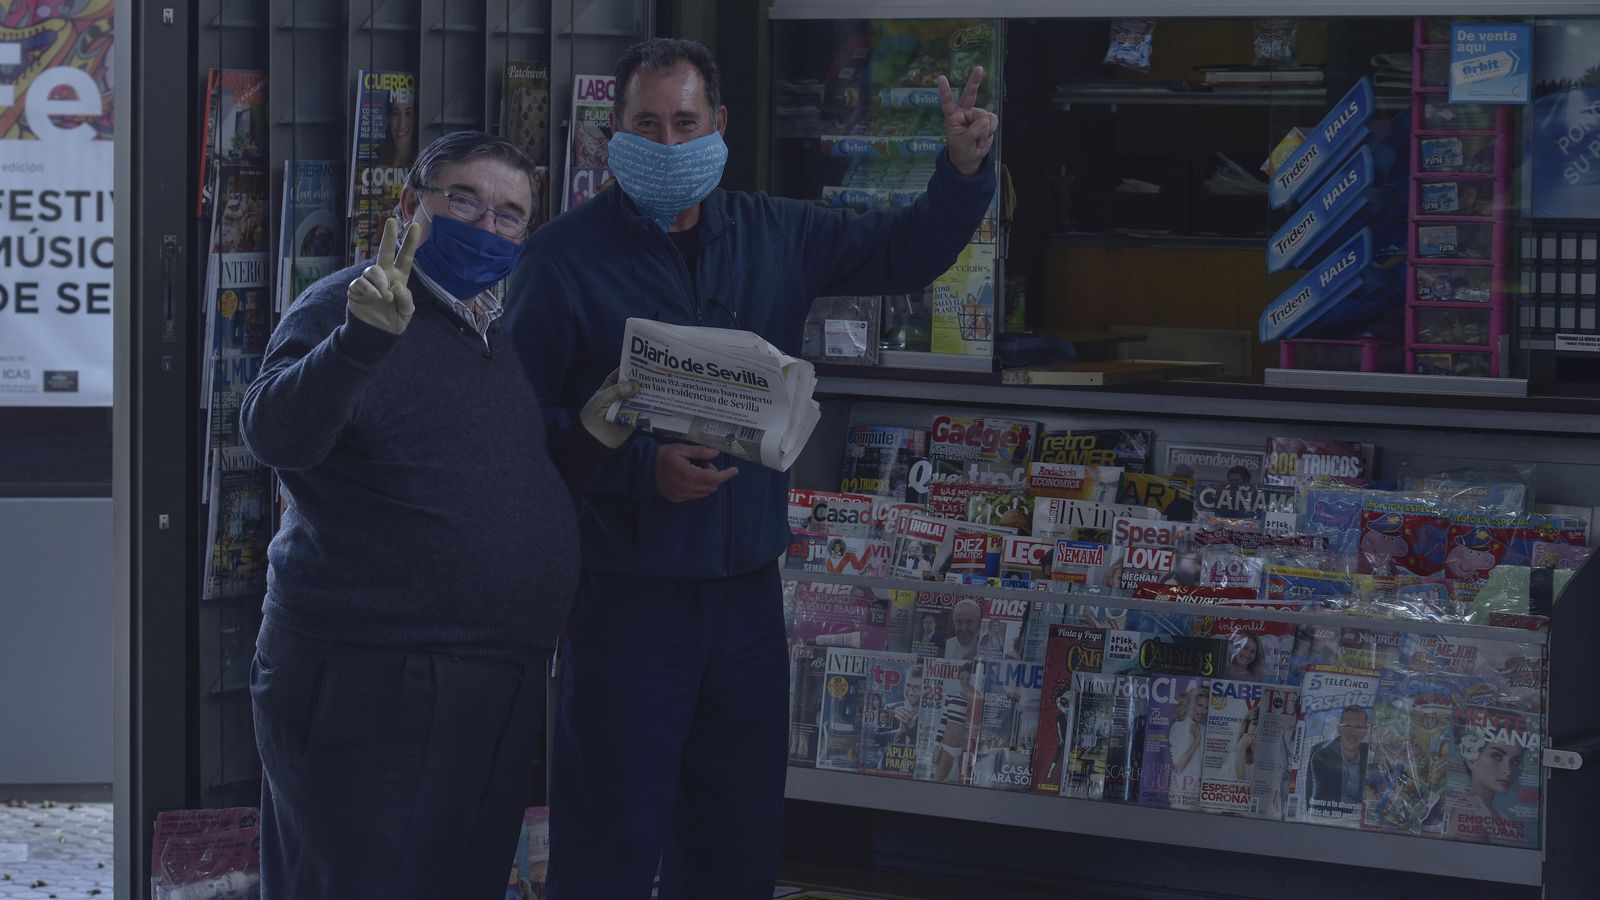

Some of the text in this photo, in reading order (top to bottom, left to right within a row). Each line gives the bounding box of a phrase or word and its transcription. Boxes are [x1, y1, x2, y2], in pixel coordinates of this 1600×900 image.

[1456, 30, 1518, 42] De venta
[1456, 41, 1487, 55] aquí
[508, 65, 549, 80] Patchwork
[1462, 58, 1500, 76] Orbit
[364, 73, 416, 90] CUERPO
[1278, 101, 1360, 191] HALLS Trident
[1563, 154, 1591, 185] SU
[0, 190, 114, 221] ESTI
[1275, 170, 1359, 256] HALLS Trident
[945, 261, 991, 273] ecciones
[1269, 250, 1357, 327] HALLS Trident
[630, 336, 769, 389] Diario de Sevilla
[3, 369, 31, 380] ICAS
[628, 368, 639, 379] Al
[638, 372, 667, 384] menos
[680, 381, 720, 395] ancianos
[720, 387, 738, 399] han
[739, 393, 773, 406] muerto
[652, 382, 666, 393] las
[666, 387, 717, 404] residencias
[717, 394, 729, 406] de
[729, 398, 760, 414] Sevilla
[931, 416, 1032, 454] Gadget
[1042, 431, 1097, 451] retro
[1170, 449, 1259, 471] Emprendedores
[1302, 454, 1361, 478] TRUCOS
[1059, 499, 1133, 529] livin
[908, 517, 945, 537] ¡HOLA!
[953, 537, 983, 553] DIEZ
[953, 549, 984, 560] MINUTOS
[1057, 540, 1105, 567] SEMANA
[1123, 548, 1175, 572] LOVE
[1120, 572, 1158, 584] MEGHAN
[1084, 629, 1104, 641] Pega
[1110, 635, 1133, 645] stick
[1358, 631, 1401, 648] NINJAGO
[923, 686, 944, 702] 28
[1483, 726, 1540, 749] SANA
[1202, 782, 1252, 797] ESPECIAL
[1457, 814, 1525, 830] EMOCIONES
[1457, 824, 1525, 840] QUE CURAN
